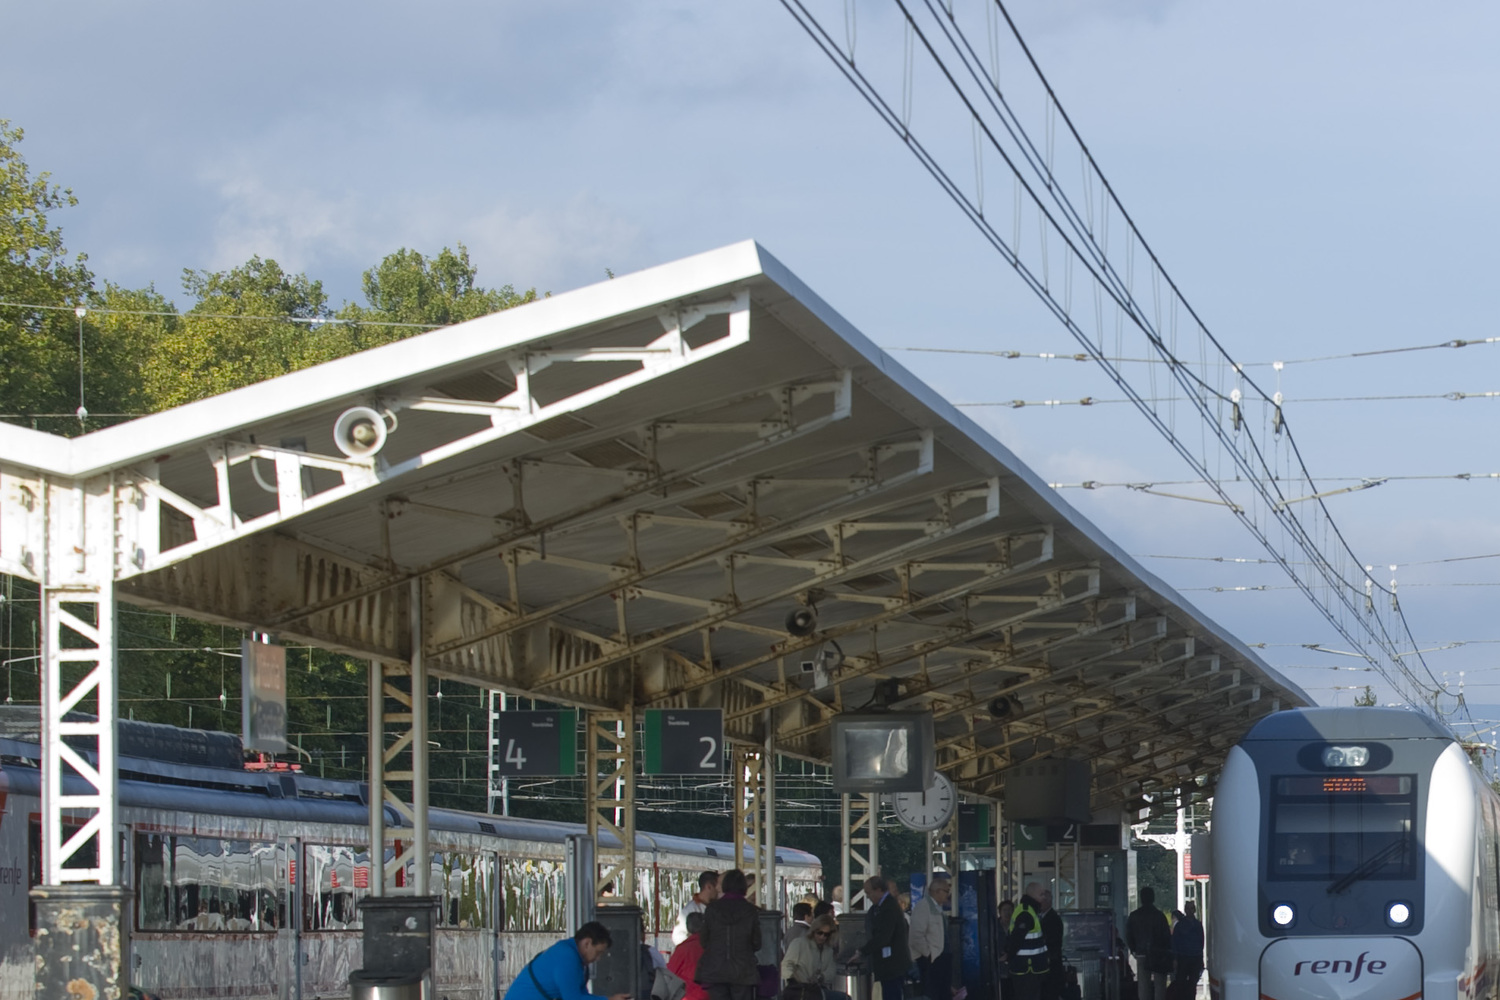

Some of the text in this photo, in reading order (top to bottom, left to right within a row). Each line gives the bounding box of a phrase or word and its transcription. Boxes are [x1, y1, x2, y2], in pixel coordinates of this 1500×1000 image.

[504, 738, 527, 770] 4
[699, 736, 717, 769] 2
[1293, 951, 1387, 983] renfe
